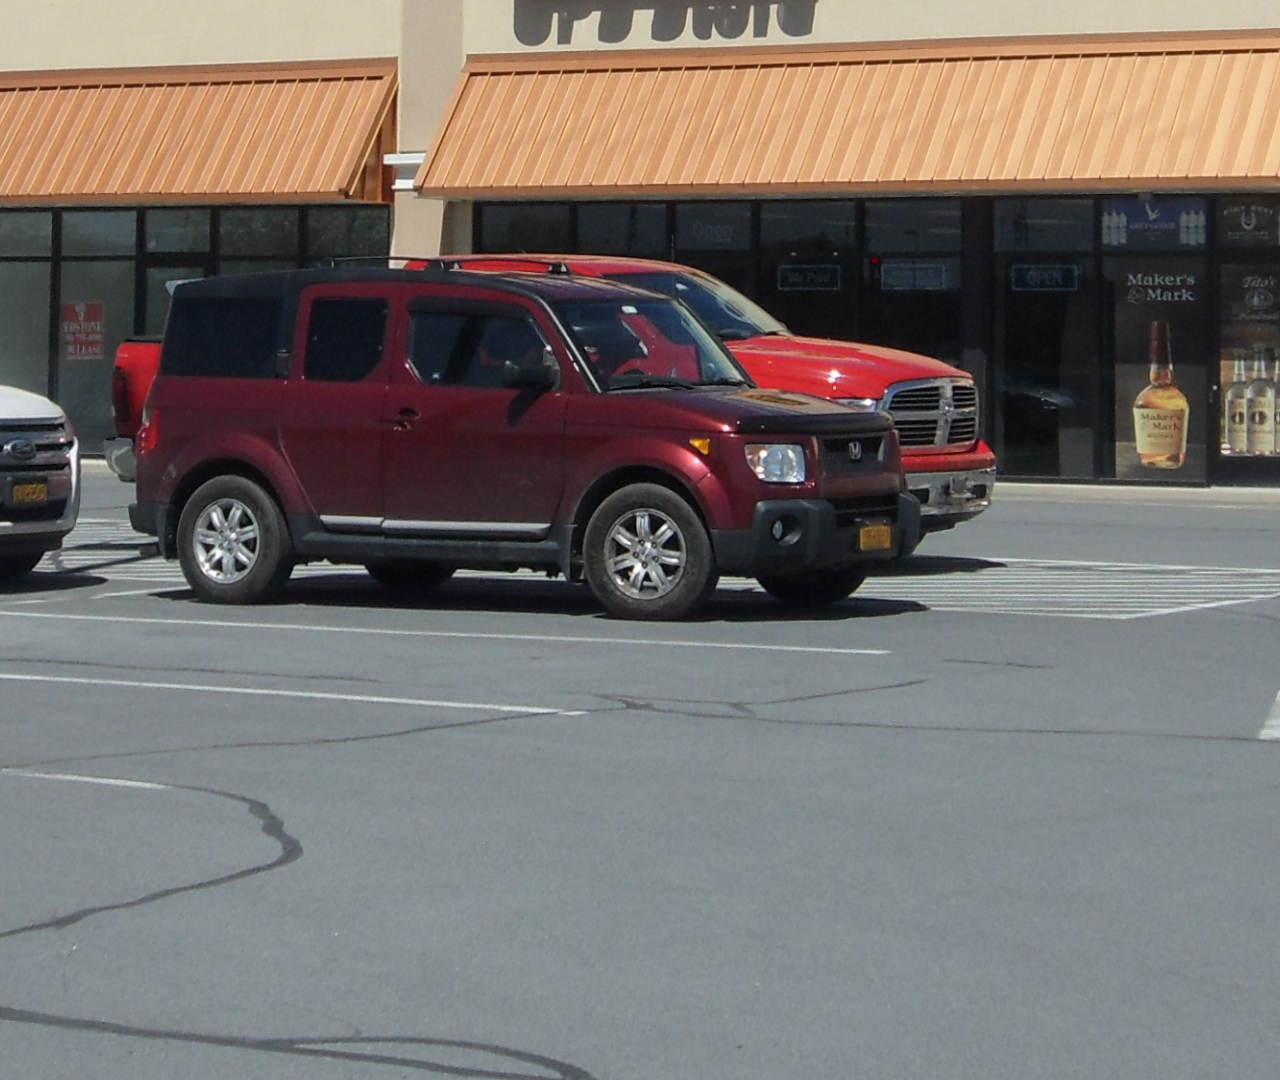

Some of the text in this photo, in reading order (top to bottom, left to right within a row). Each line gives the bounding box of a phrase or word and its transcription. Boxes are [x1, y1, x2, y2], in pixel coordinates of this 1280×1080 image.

[692, 221, 733, 241] Open
[1025, 269, 1063, 286] OPEN
[1127, 274, 1196, 286] Maker's
[1147, 289, 1195, 301] Mark
